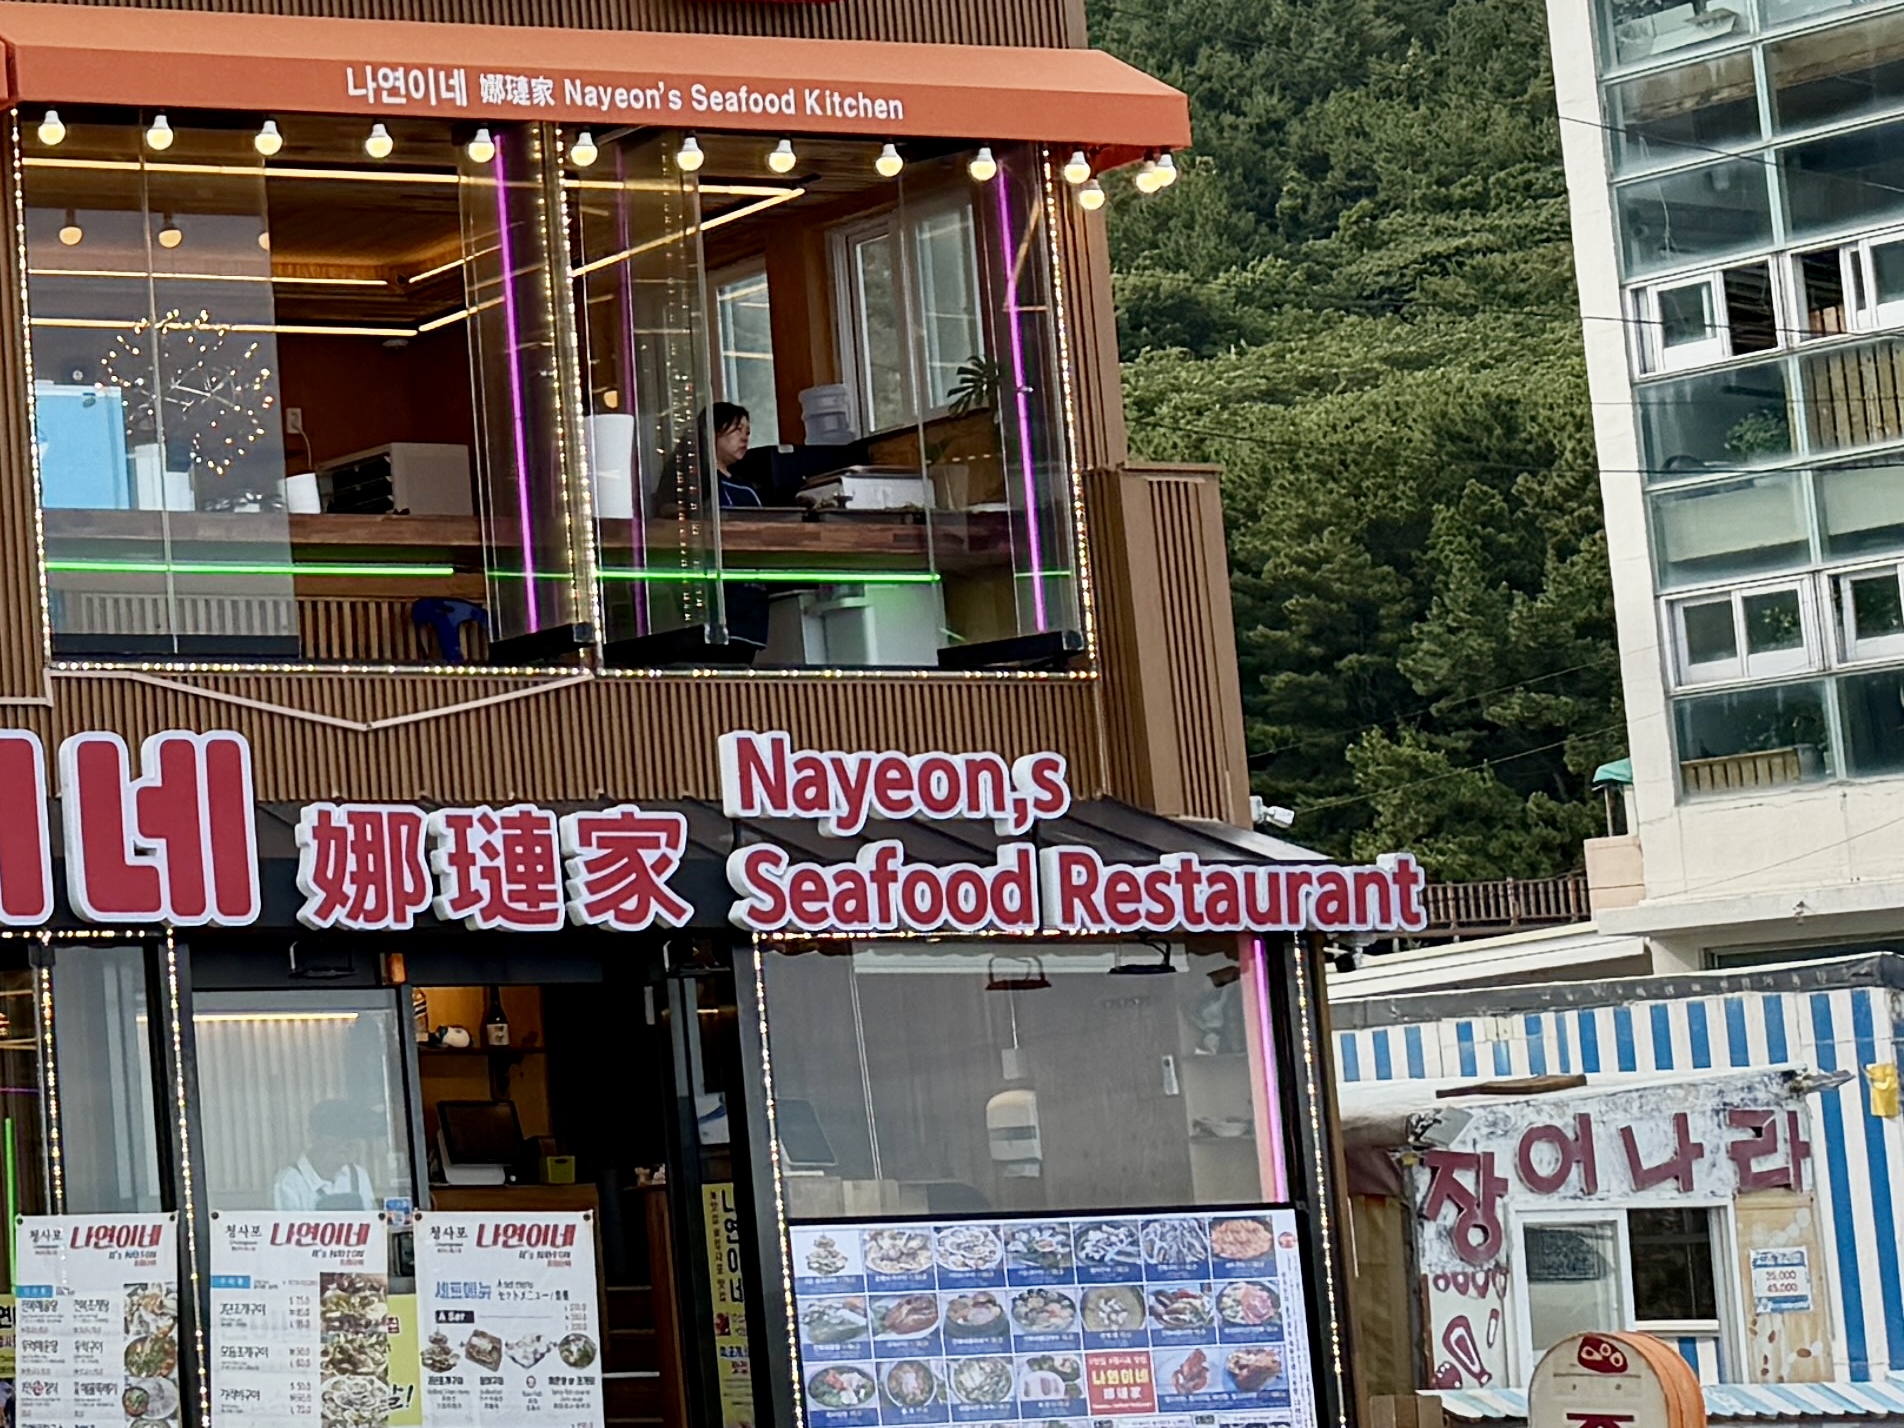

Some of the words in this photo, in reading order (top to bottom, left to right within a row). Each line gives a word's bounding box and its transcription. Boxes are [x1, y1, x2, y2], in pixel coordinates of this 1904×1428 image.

[345, 64, 468, 106] 나연이네
[563, 76, 682, 114] Nayeon's
[691, 80, 796, 117] Seafood
[803, 88, 905, 121] Kitchen
[727, 838, 1040, 934] Seafood
[1043, 845, 1429, 933] Restaurant
[1421, 1109, 1813, 1265] 장어나라
[70, 1224, 163, 1250] 나연이네
[270, 1222, 371, 1247] 나연이네
[476, 1223, 577, 1249] 나연이네
